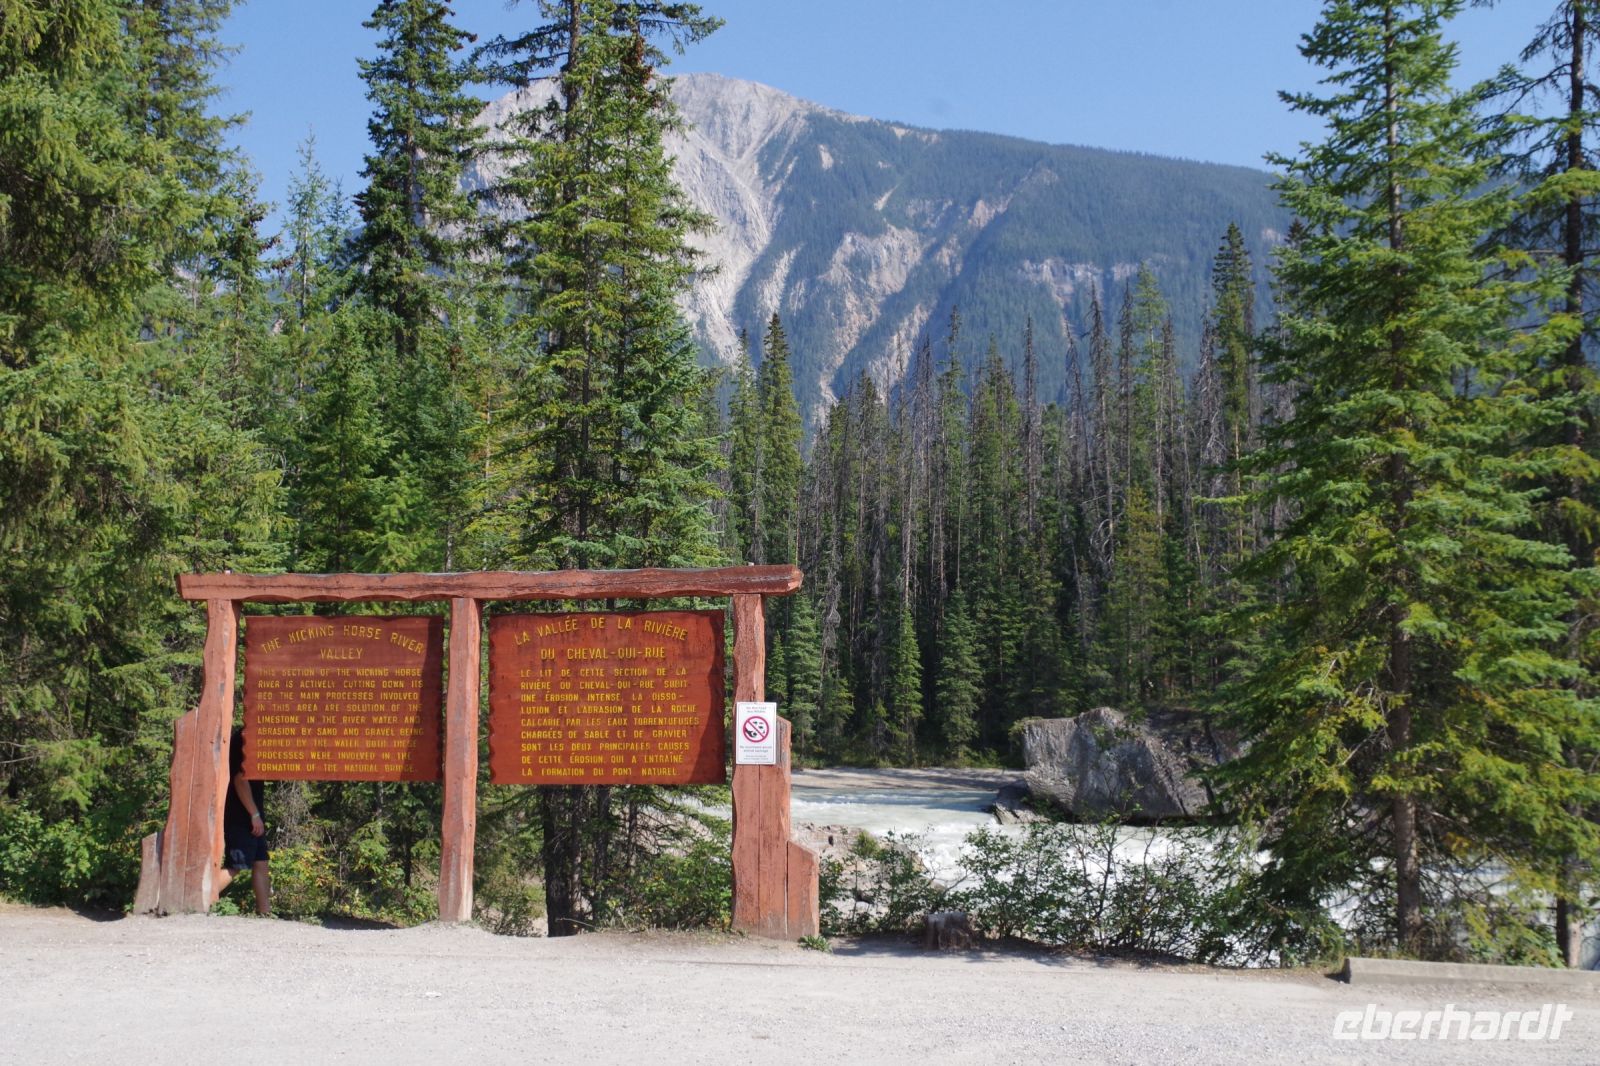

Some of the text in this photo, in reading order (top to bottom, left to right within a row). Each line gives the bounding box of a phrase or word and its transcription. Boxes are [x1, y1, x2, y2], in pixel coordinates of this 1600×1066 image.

[514, 616, 688, 646] LA VALLÉE DE LA RIVIÈRE
[260, 624, 424, 654] THE KICKING HORSE RIVER
[320, 648, 364, 660] VALLEY
[540, 648, 555, 660] DU
[520, 667, 687, 678] LE LIT DE CETTE SECTION DE LA
[258, 680, 280, 689] RIVER
[285, 680, 294, 689] IS
[520, 678, 551, 690] RIVIÈRE
[560, 681, 571, 690] DU
[300, 692, 320, 700] MAIN
[326, 692, 374, 700] PROCESSES
[380, 692, 419, 700] INVOLVED
[520, 693, 536, 702] UNE
[545, 690, 579, 702] ÉROSION
[632, 692, 643, 701] LA
[296, 704, 318, 712] AREA
[324, 704, 340, 712] ARE
[346, 704, 385, 712] SOLUTION
[520, 706, 550, 714] LUTION
[558, 706, 568, 714] ET
[631, 704, 642, 714] DE
[651, 704, 662, 714] LA
[670, 704, 696, 713] ROCHE
[257, 716, 421, 724] LIMESTONE IN THE RIVER WATER AND
[566, 718, 581, 726] PAR
[586, 718, 600, 726] LES
[607, 717, 628, 726] EAUX
[257, 728, 424, 736] ABRASION BY SAND AND GRAVEL BEING
[568, 730, 577, 739] DE
[584, 730, 610, 738] SABLE
[616, 730, 626, 738] ET
[634, 730, 644, 738] DE
[652, 729, 687, 738] GRAVIER
[521, 742, 690, 752] SONT LES DEUX PRINCIPALES CAUSES
[256, 752, 305, 760] PROCESSES
[310, 752, 332, 760] WERE
[338, 752, 376, 760] INVOLVED
[382, 752, 391, 760] IN
[521, 756, 532, 764] DE
[538, 755, 562, 764] CETTE
[610, 755, 624, 764] QUI
[256, 764, 300, 772] FORMATION
[306, 764, 316, 772] OF
[344, 764, 378, 772] NATURAL
[521, 768, 533, 776] LA
[541, 768, 584, 776] FORMATION
[592, 768, 604, 776] DU
[612, 768, 632, 776] PONT
